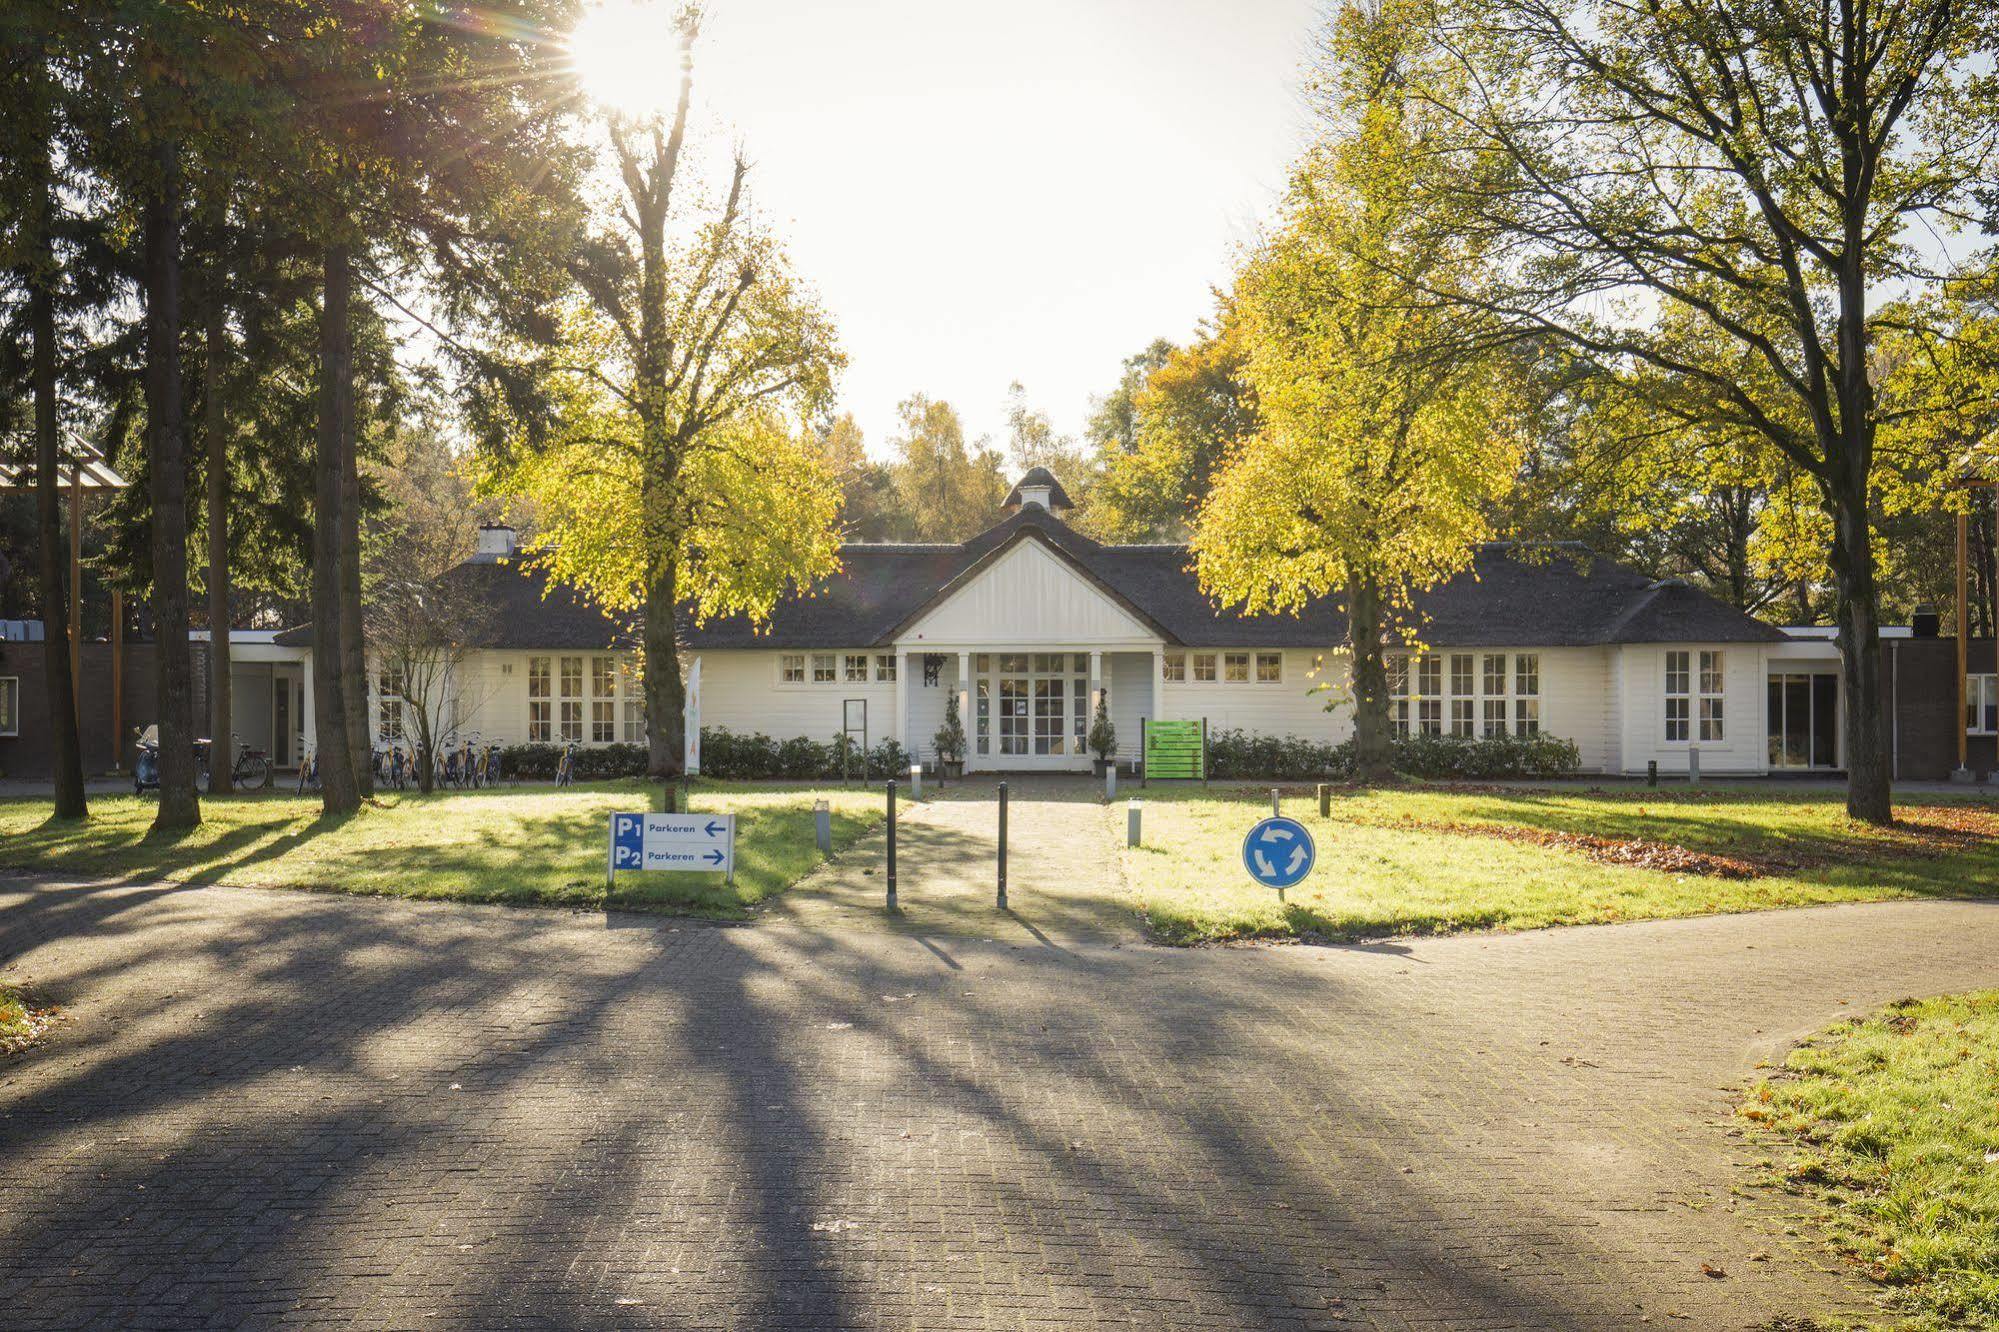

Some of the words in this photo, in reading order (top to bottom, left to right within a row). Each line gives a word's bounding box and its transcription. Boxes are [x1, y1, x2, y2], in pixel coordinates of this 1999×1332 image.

[617, 817, 641, 837] P1
[649, 824, 695, 833] Parkeren
[615, 846, 641, 866] P2
[648, 852, 695, 861] Parkeren
